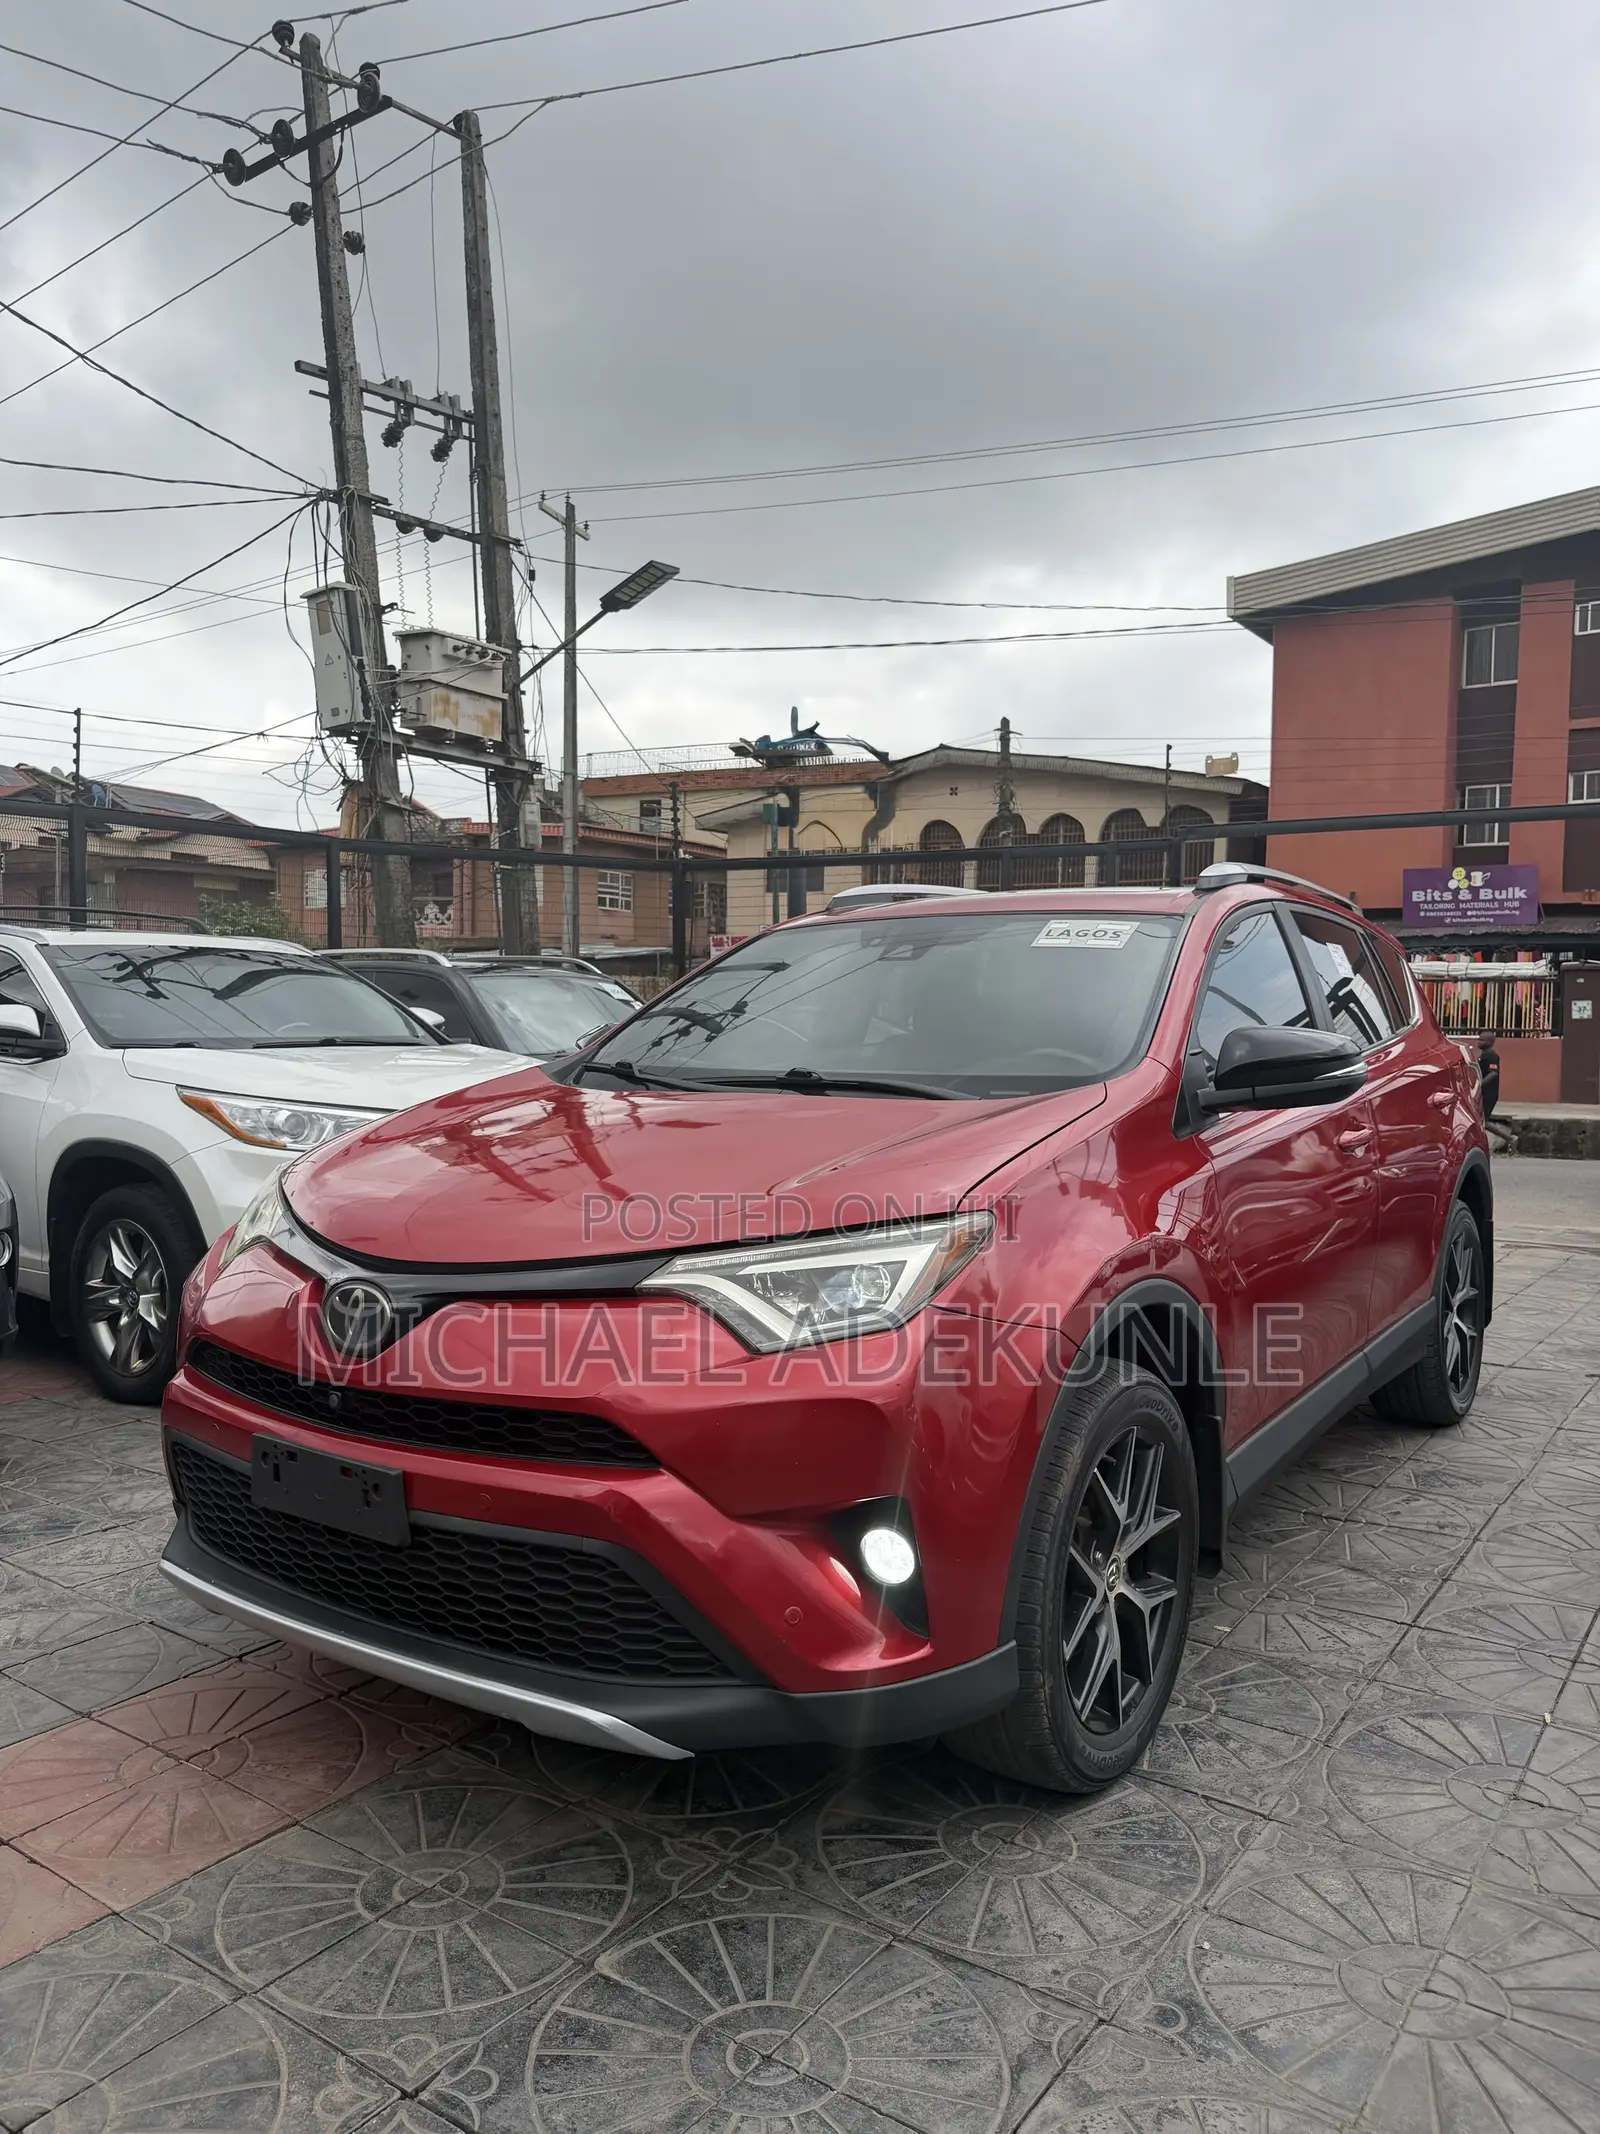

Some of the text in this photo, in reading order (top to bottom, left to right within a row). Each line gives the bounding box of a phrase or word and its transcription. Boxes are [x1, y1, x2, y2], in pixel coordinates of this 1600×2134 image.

[1412, 887, 1527, 902] Bits & Bulk
[1045, 929, 1123, 938] LAGOS
